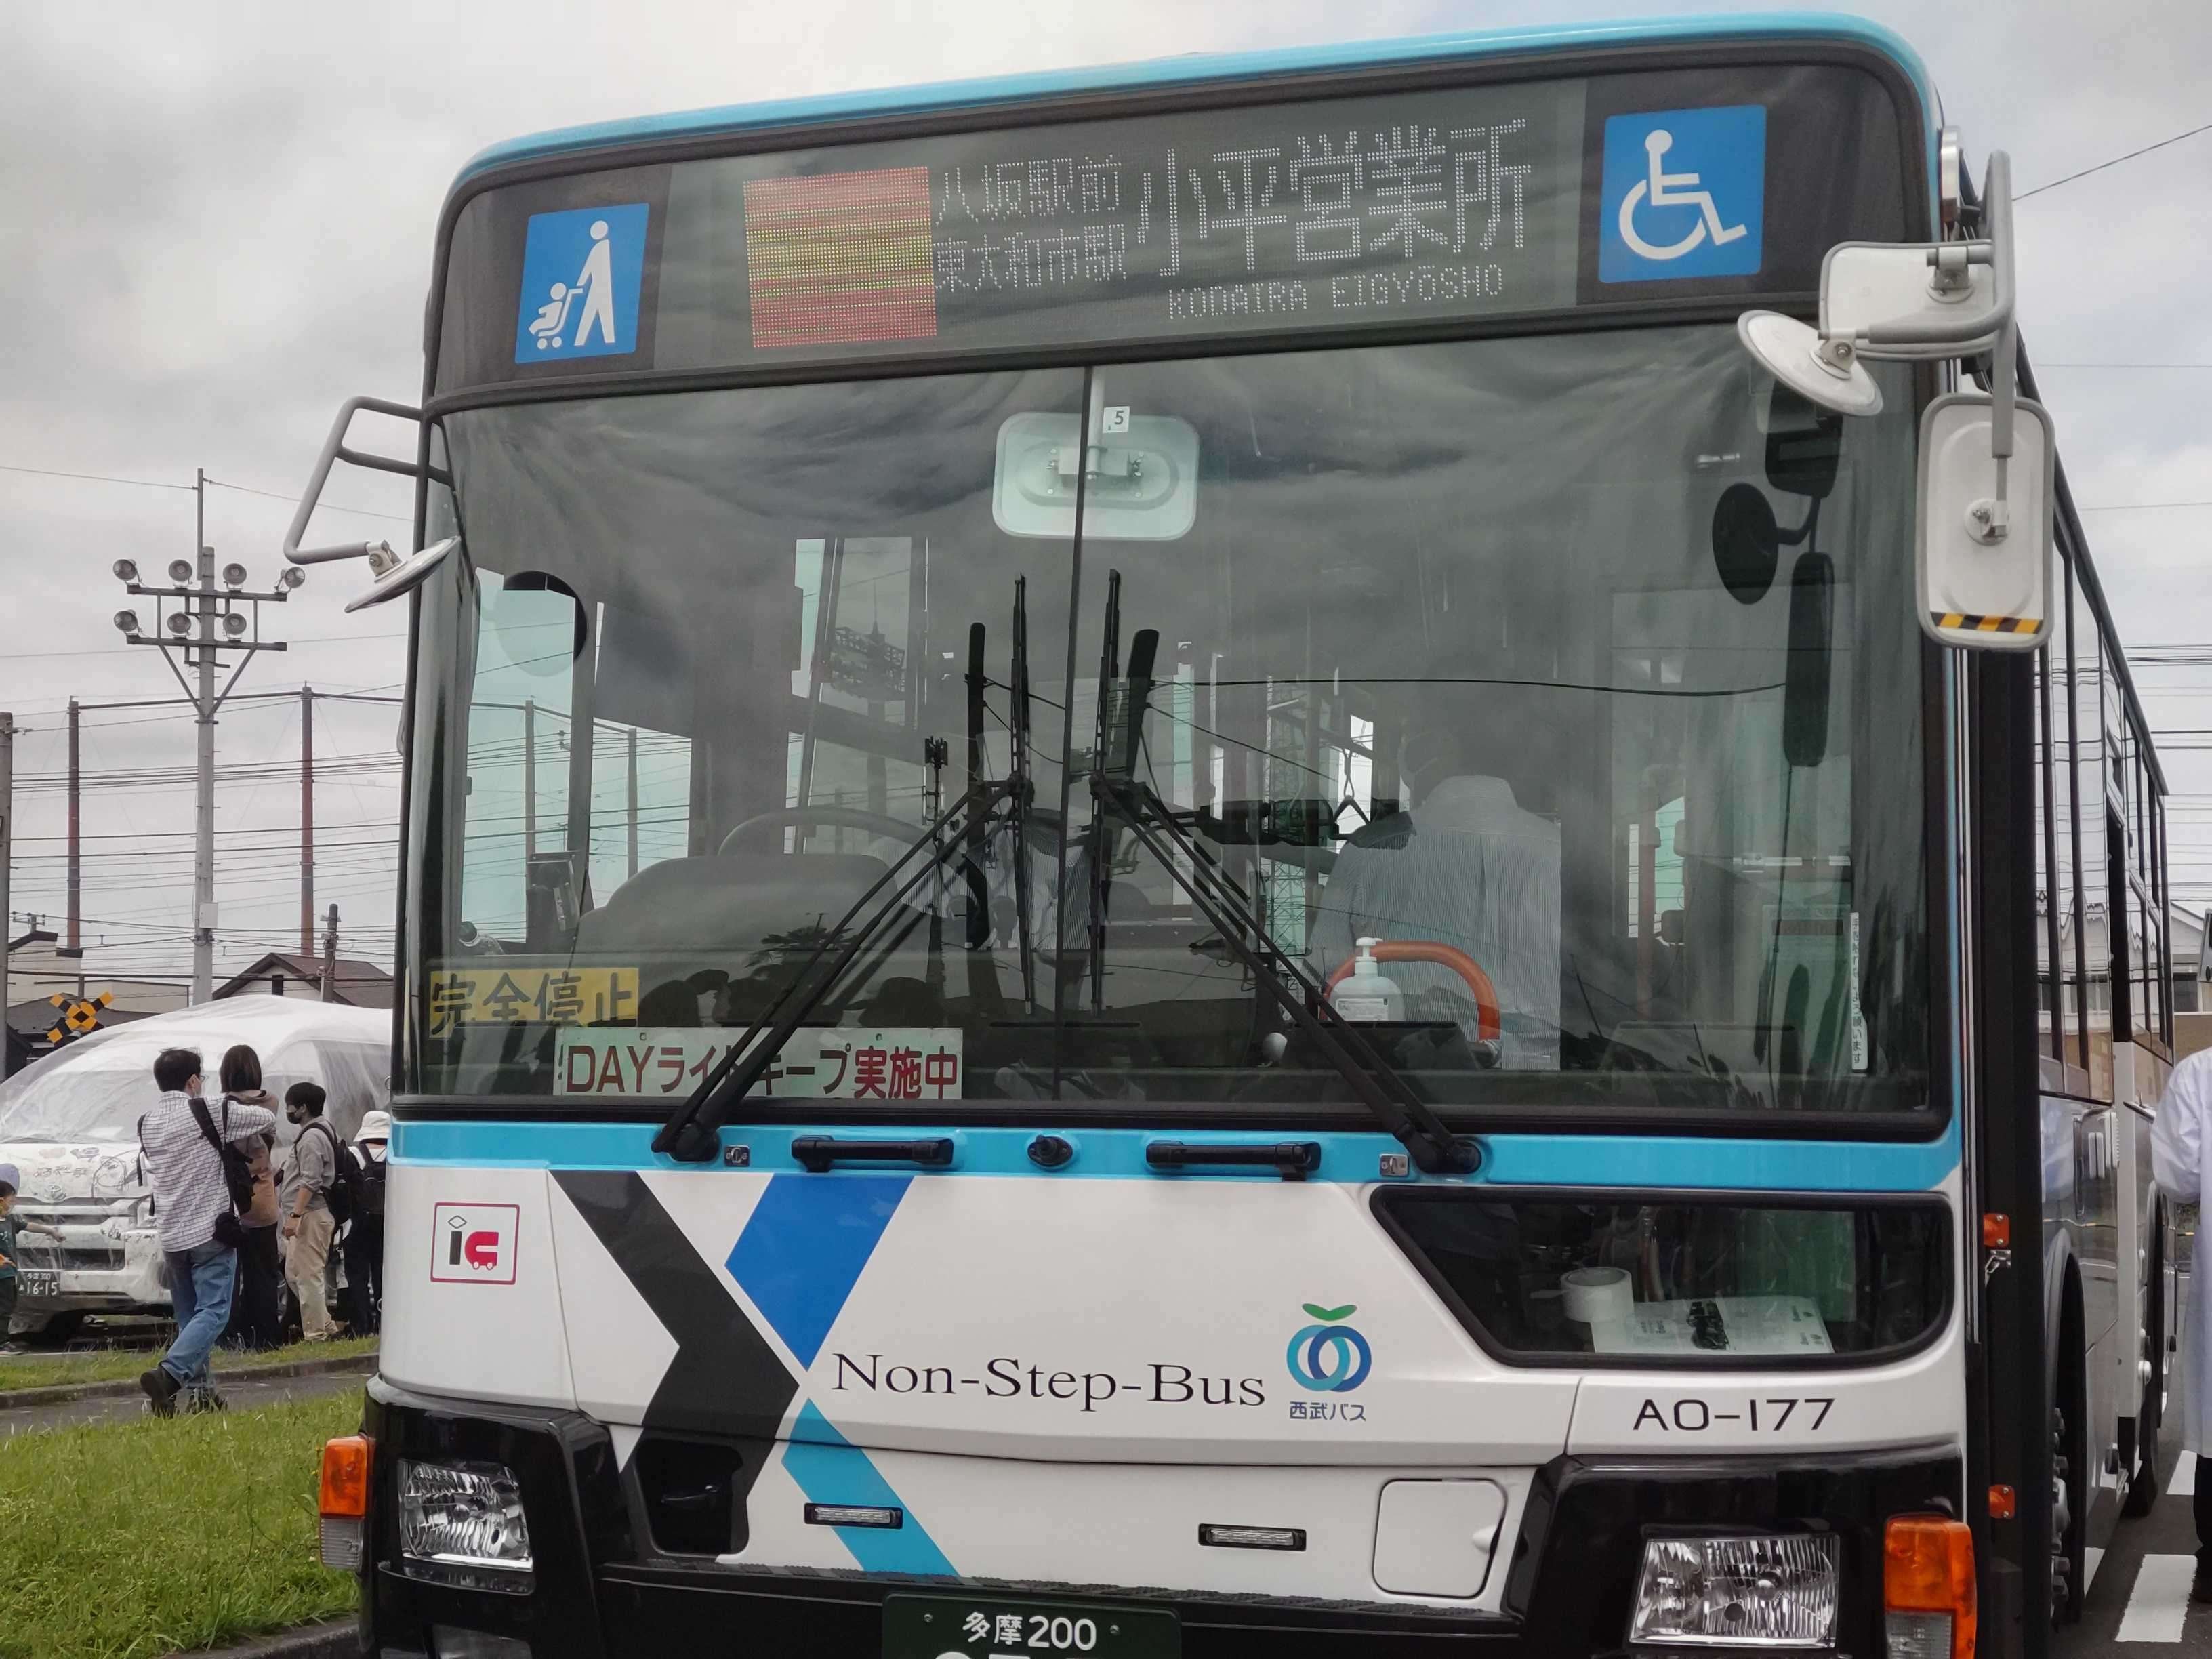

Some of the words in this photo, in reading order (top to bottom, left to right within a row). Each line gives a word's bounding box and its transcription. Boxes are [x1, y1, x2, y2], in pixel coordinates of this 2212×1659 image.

[935, 154, 1122, 225] 八坂駅前
[1136, 118, 1532, 277] 小平営業所
[933, 223, 1127, 293] 東大和市駅
[1168, 279, 1308, 320] KODAIRA
[1114, 409, 1125, 426] 5
[431, 970, 638, 1036] 完全停止
[831, 1352, 1267, 1412] Non-Step-Bus
[1289, 1400, 1368, 1422] 西武バス
